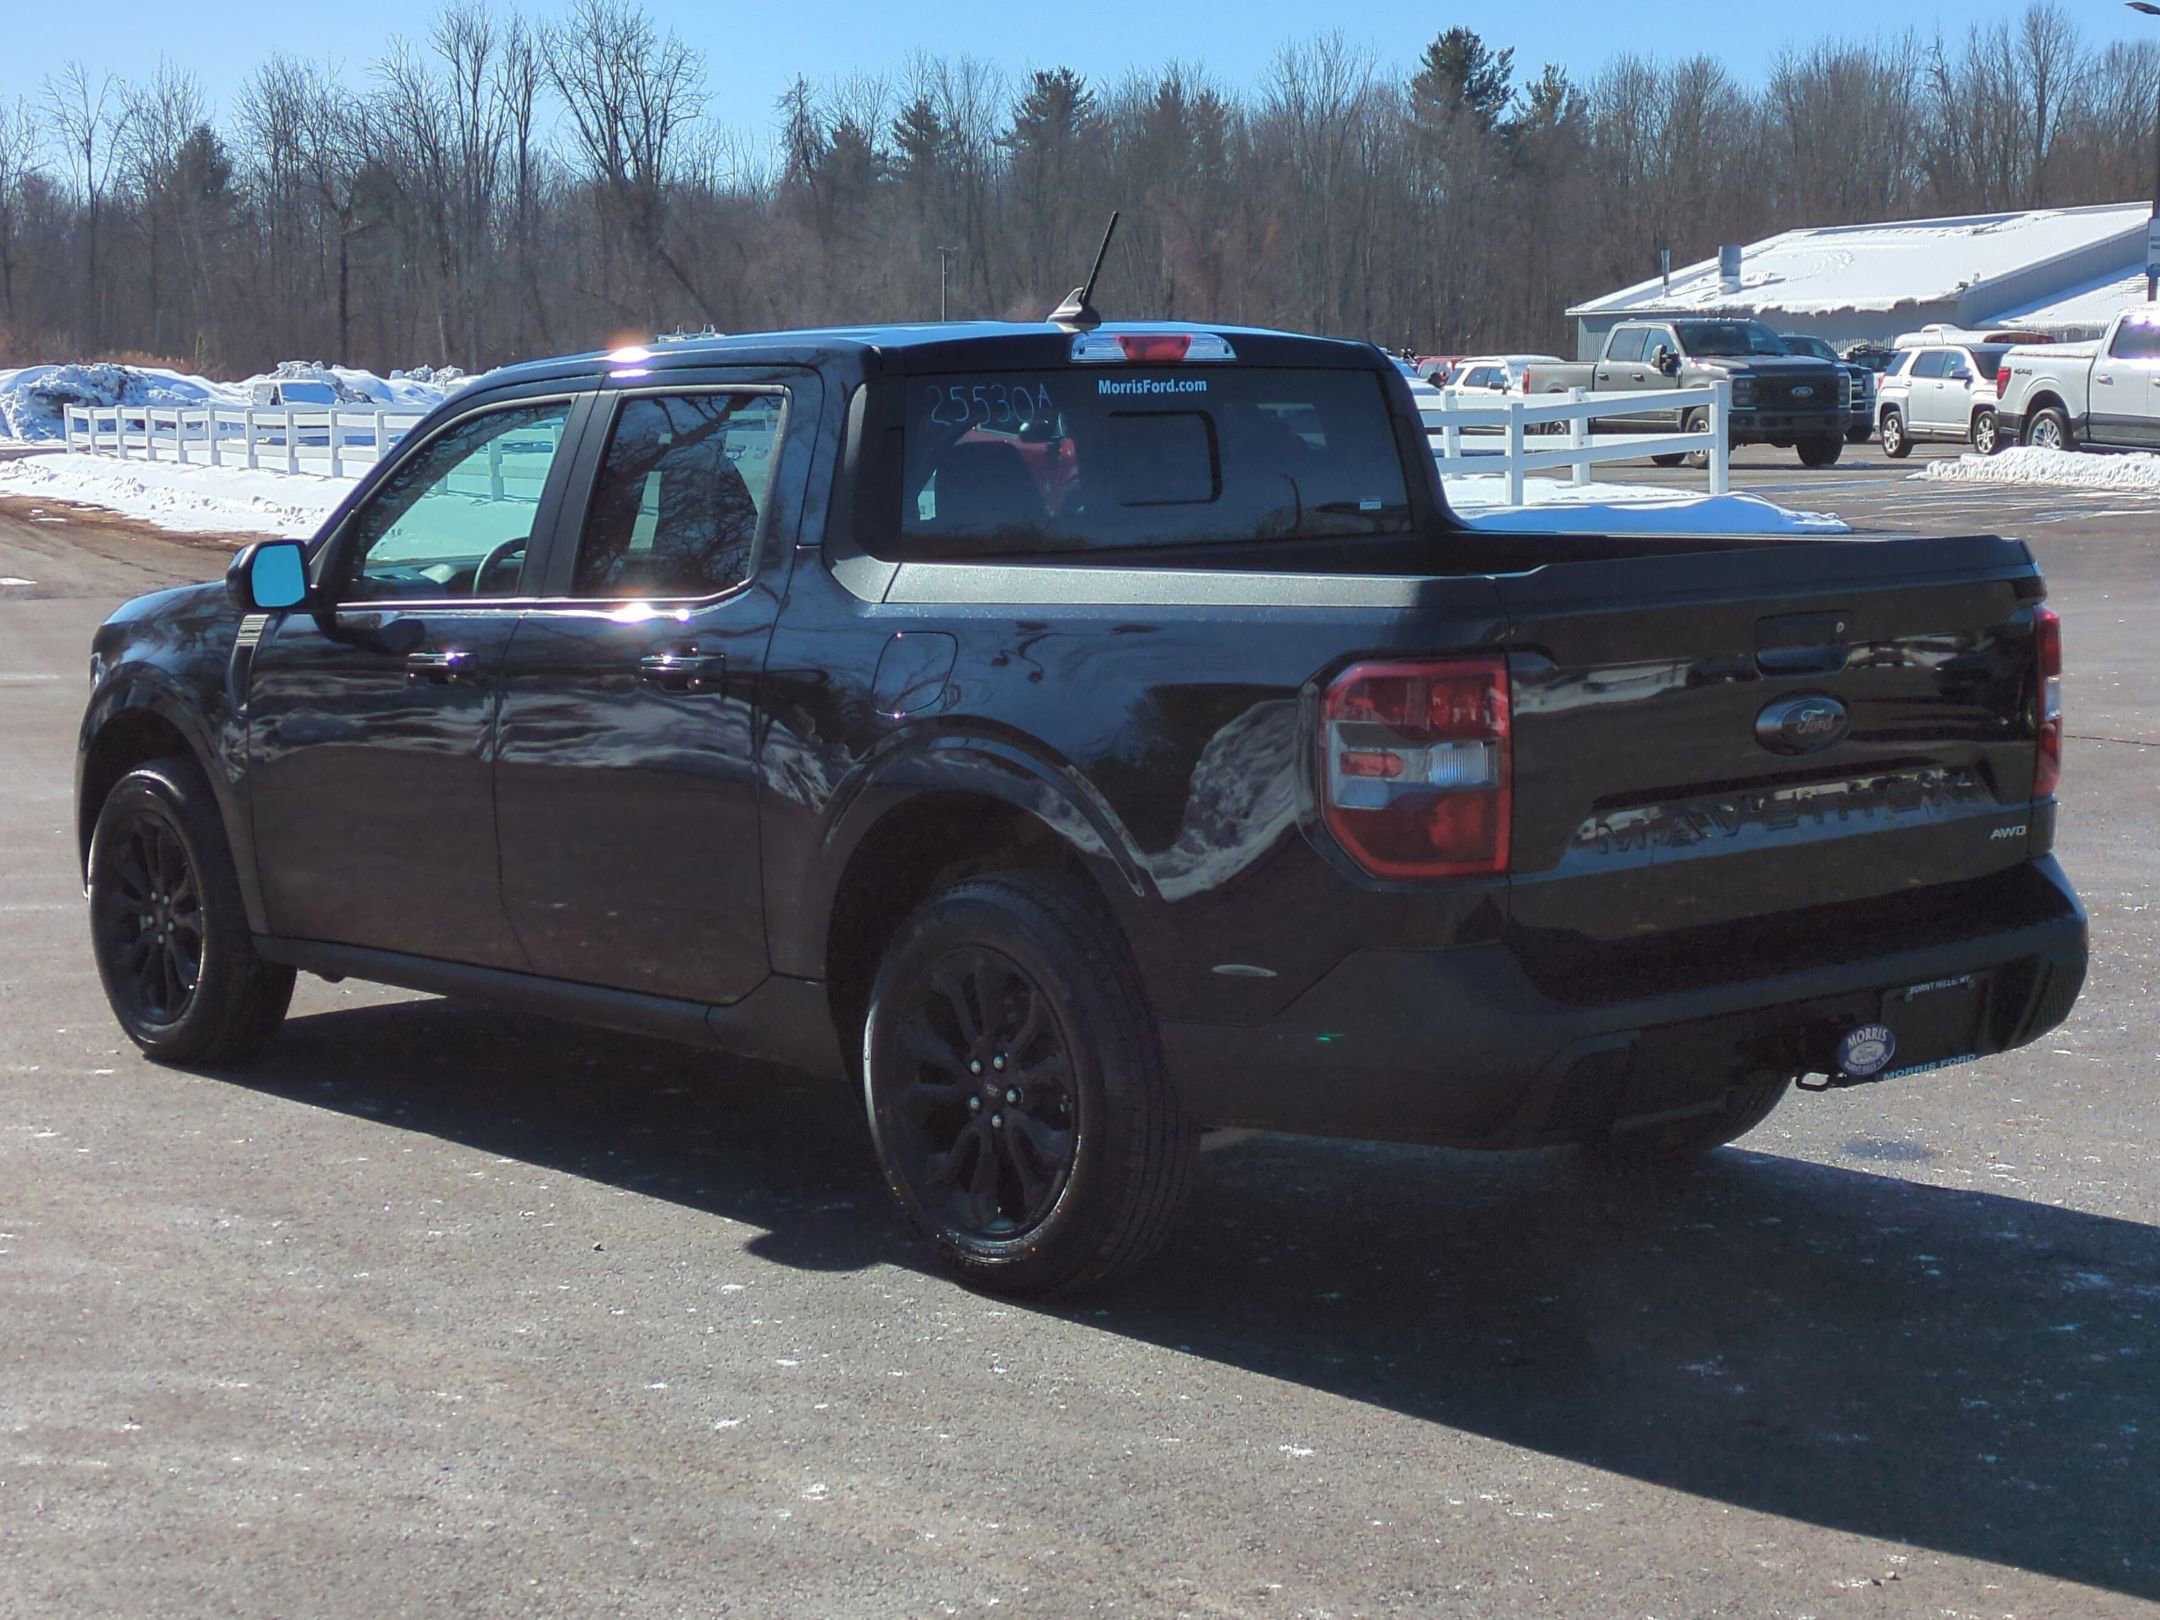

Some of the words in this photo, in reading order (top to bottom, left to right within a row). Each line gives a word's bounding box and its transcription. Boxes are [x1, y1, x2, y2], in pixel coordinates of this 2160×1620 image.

[1097, 378, 1208, 395] MorrisFord.com
[1796, 709, 1834, 735] Ford
[1989, 824, 2027, 841] AWD
[1847, 1027, 1889, 1050] MORRIS
[1883, 1062, 1937, 1081] MORRIS
[1939, 1053, 1976, 1070] FORD
